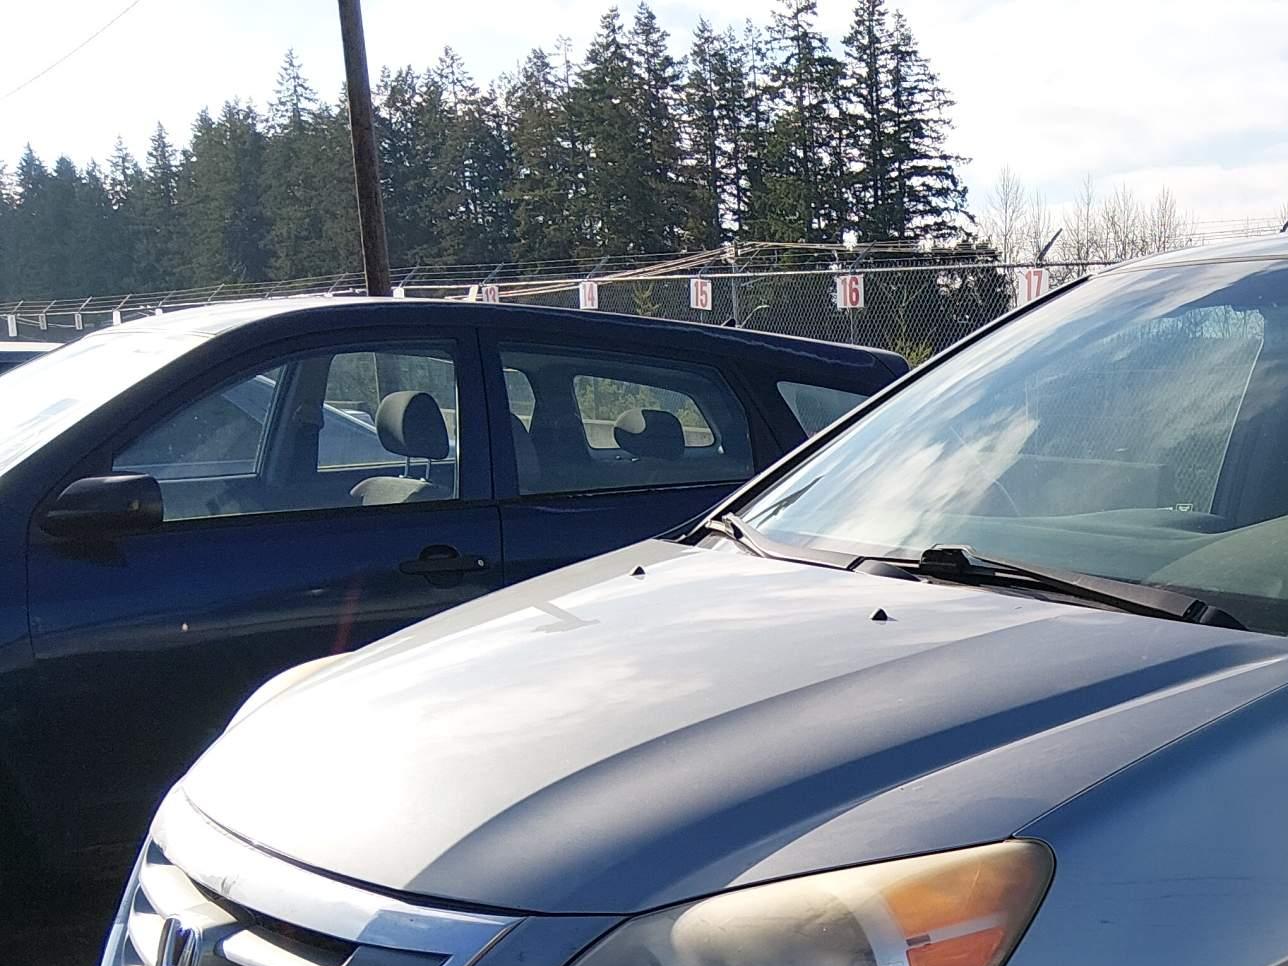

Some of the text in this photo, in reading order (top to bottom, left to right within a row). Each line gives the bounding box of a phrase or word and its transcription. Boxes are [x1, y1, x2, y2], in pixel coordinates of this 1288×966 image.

[583, 282, 596, 307] 14
[693, 280, 709, 308] 15
[841, 276, 860, 306] 16
[1025, 270, 1043, 301] 17
